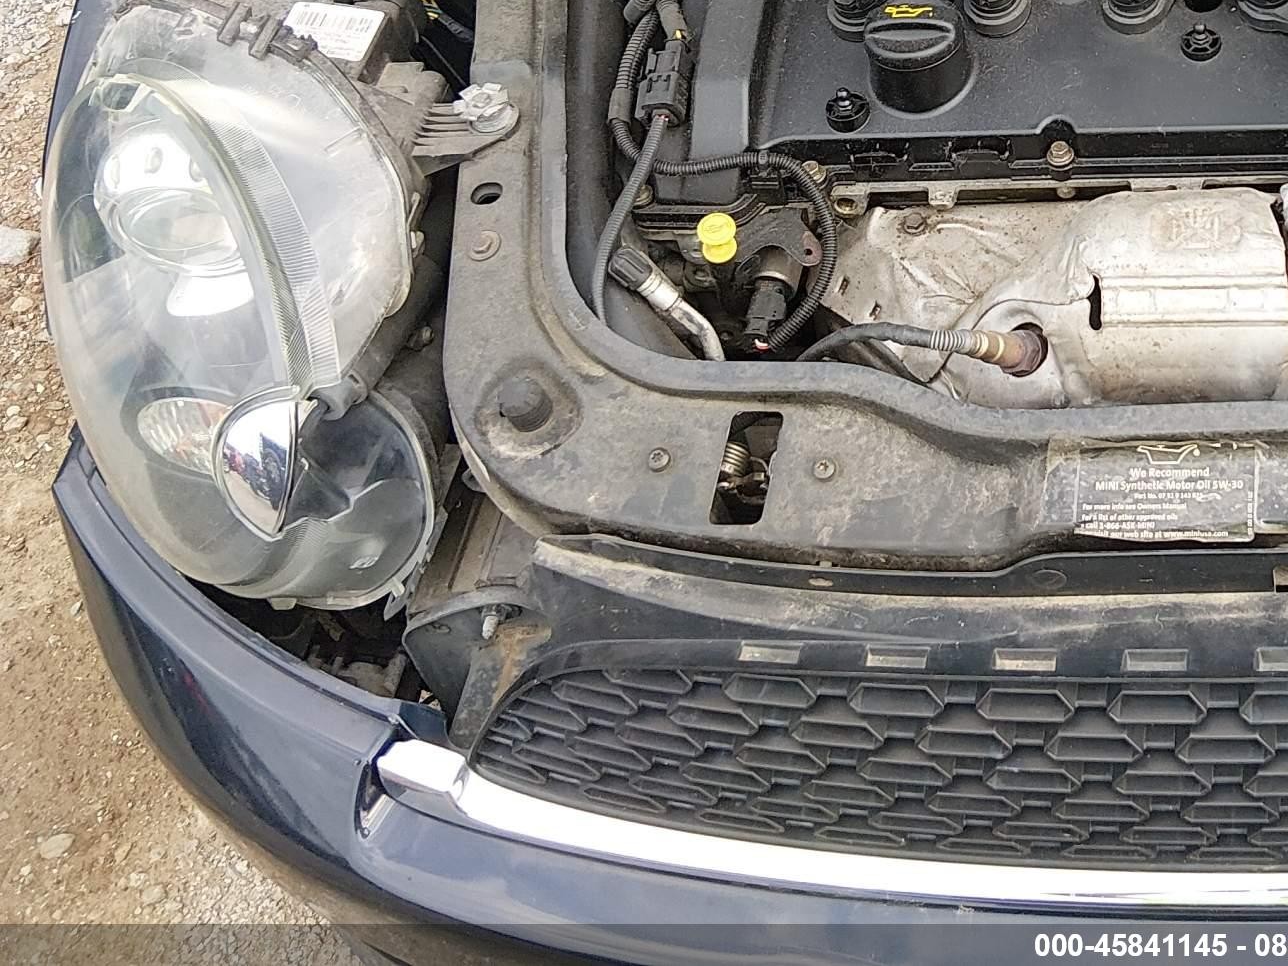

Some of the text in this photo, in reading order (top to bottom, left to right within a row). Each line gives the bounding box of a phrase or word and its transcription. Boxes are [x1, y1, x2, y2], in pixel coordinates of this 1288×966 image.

[1129, 466, 1210, 478] We Recommend
[1095, 479, 1244, 493] MINI Synthetic Motor Oil 5W-30
[1093, 503, 1111, 511] more
[1111, 502, 1125, 511] info
[1098, 514, 1109, 522] list
[1109, 514, 1117, 522] of
[1117, 514, 1136, 522] other
[1136, 514, 1166, 523] approved
[1085, 521, 1099, 529] call
[1123, 530, 1139, 538] web
[1139, 530, 1154, 538] site
[1154, 531, 1163, 539] at
[1163, 530, 1229, 540] www.miniusa.com
